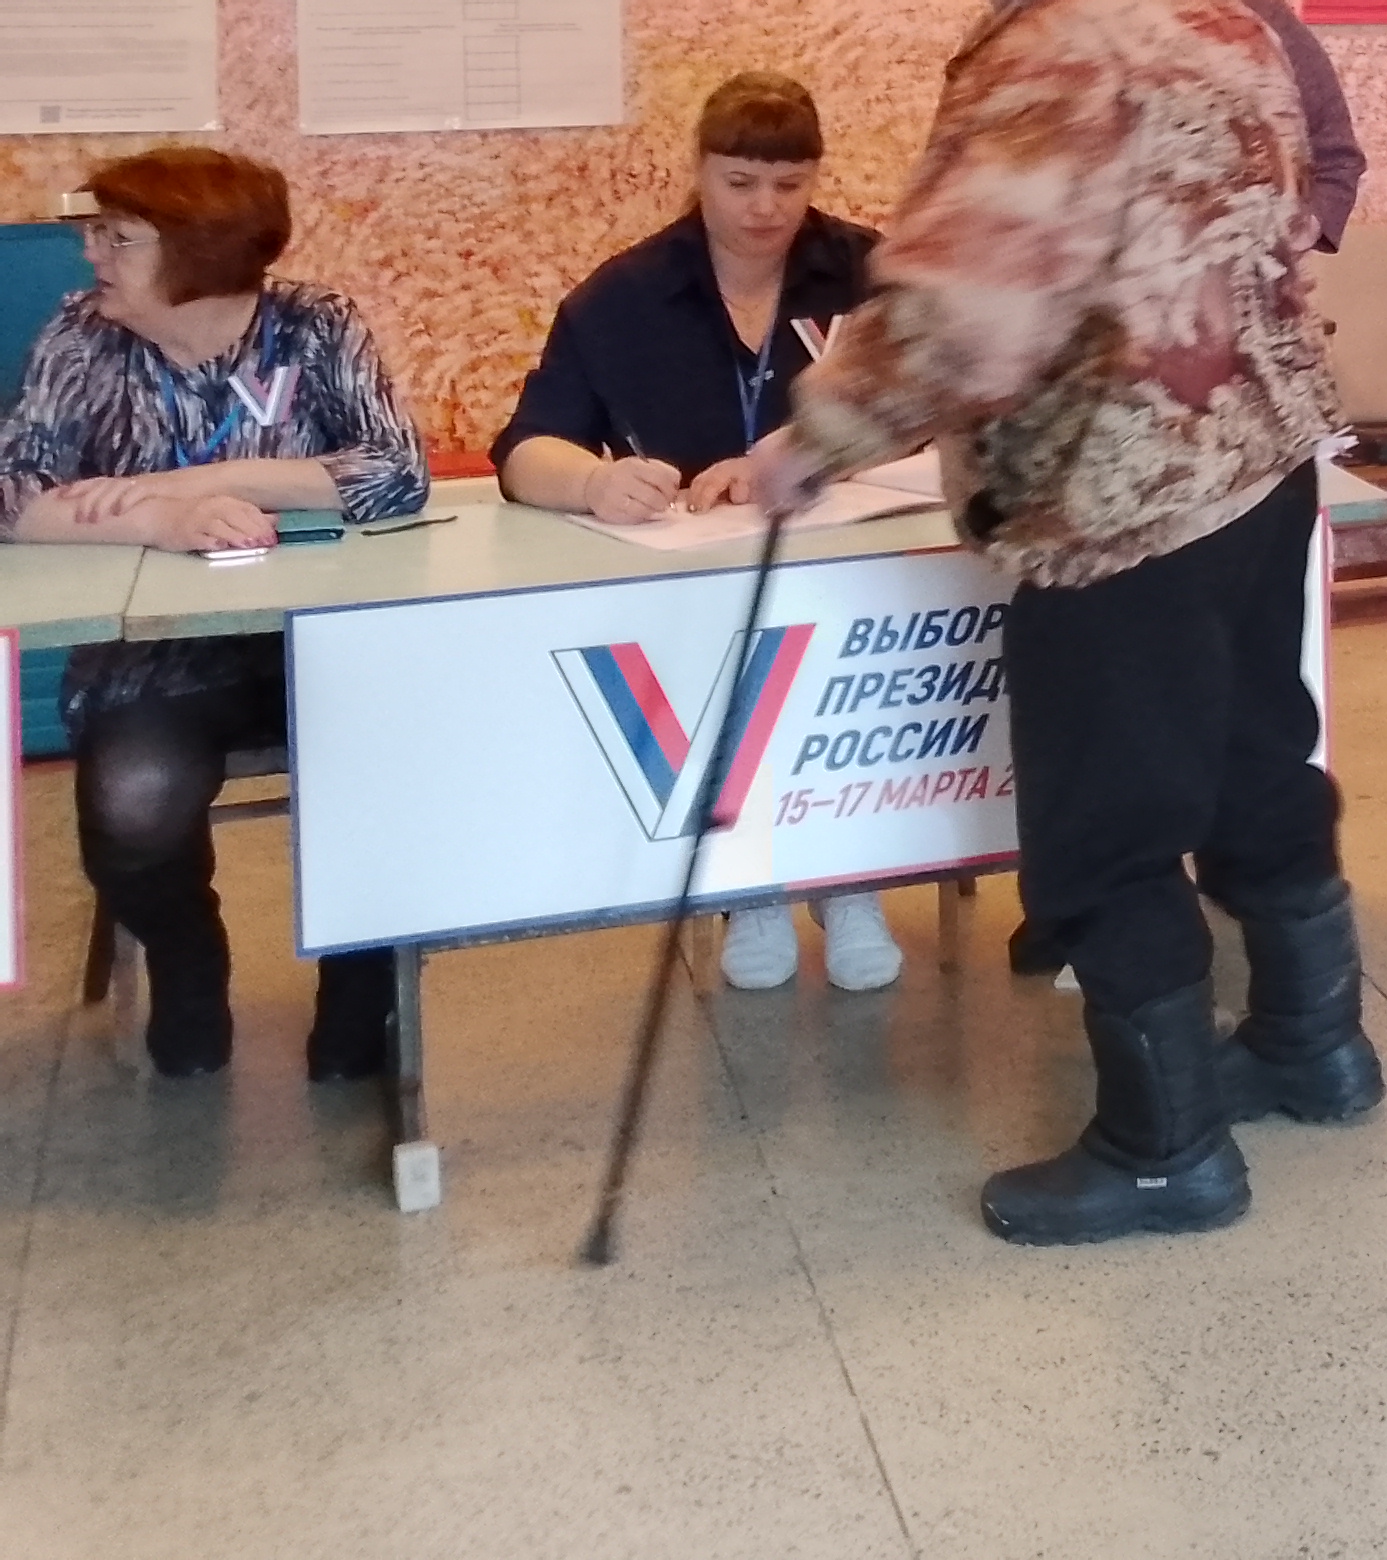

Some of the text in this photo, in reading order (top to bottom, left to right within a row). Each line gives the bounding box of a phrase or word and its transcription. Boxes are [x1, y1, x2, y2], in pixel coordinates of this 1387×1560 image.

[838, 604, 1010, 659] ВЫБОР
[814, 659, 1010, 717] ПРЕЗИД
[791, 714, 989, 775] РОССИИ
[873, 772, 988, 814] МАРТА
